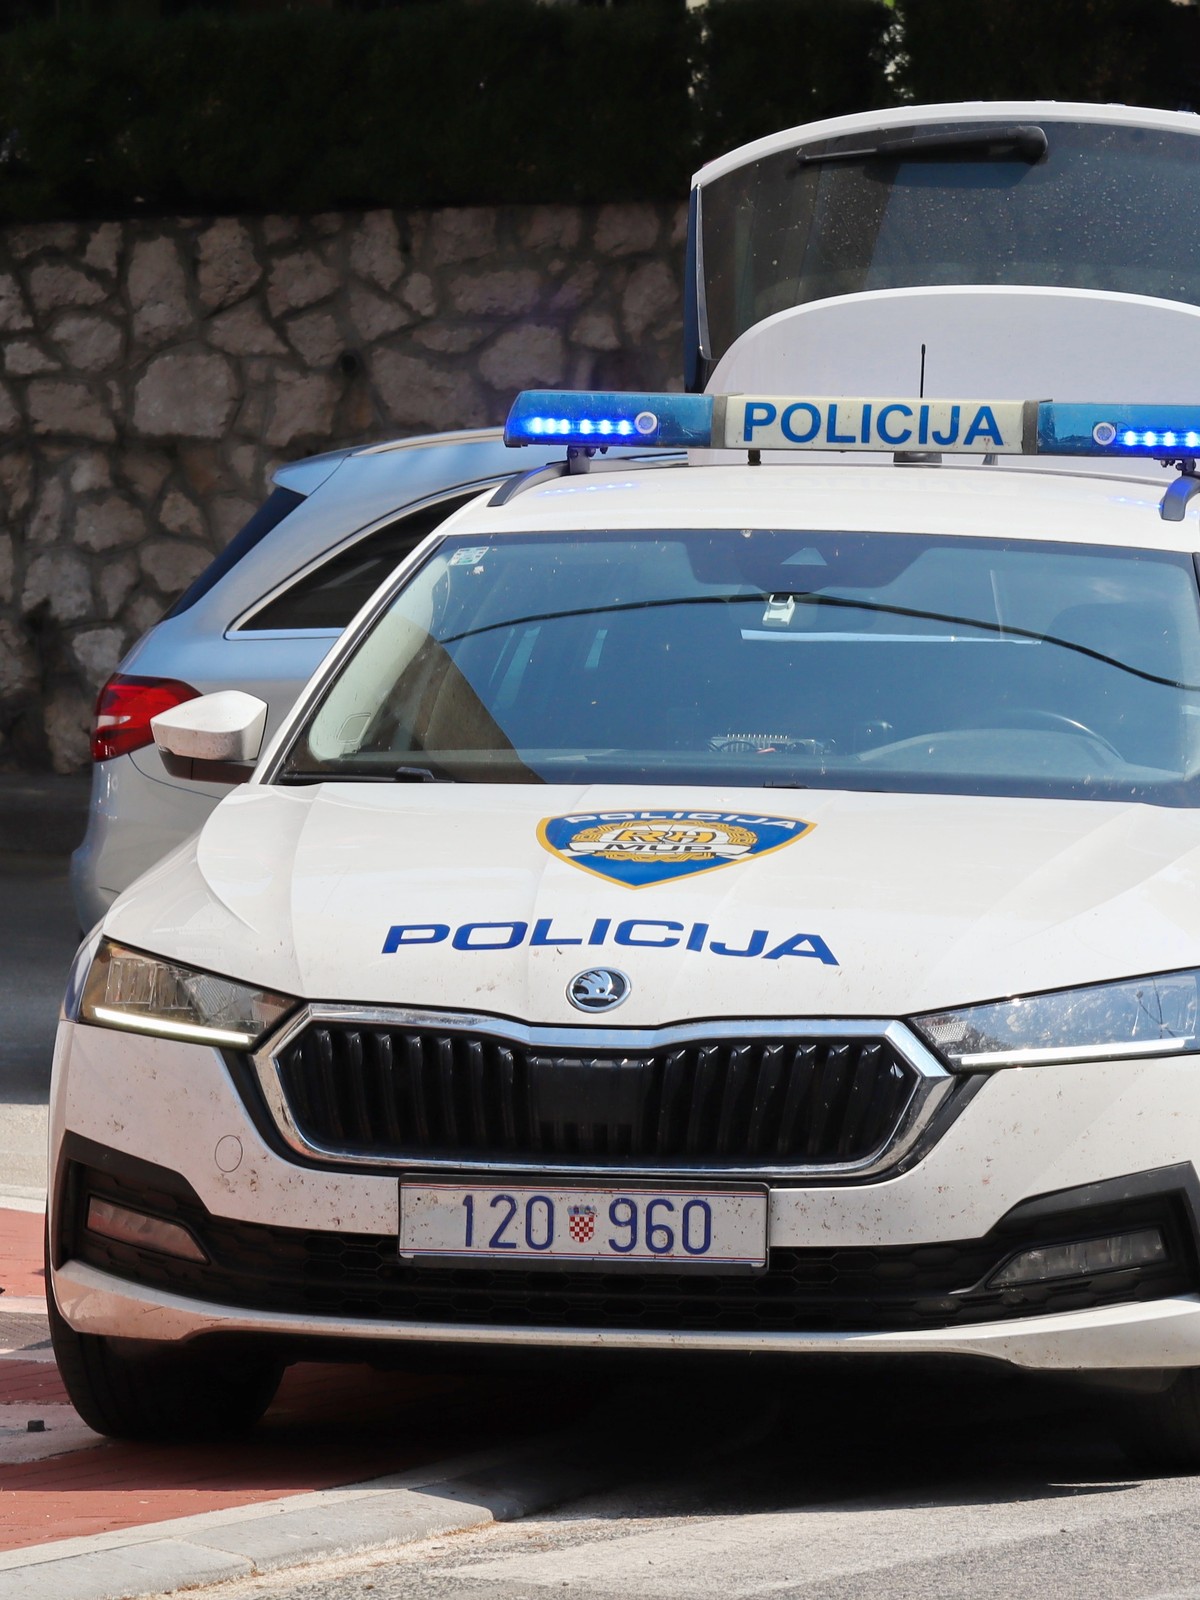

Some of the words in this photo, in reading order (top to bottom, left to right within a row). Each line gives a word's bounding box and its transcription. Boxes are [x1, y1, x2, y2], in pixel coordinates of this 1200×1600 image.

[743, 402, 1004, 446] POLICIJA
[564, 811, 797, 830] POLICIJA
[604, 843, 713, 852] MUP
[613, 830, 717, 843] RH
[381, 918, 840, 966] POLICIJA
[462, 1194, 555, 1250] 120
[608, 1197, 712, 1255] 960
